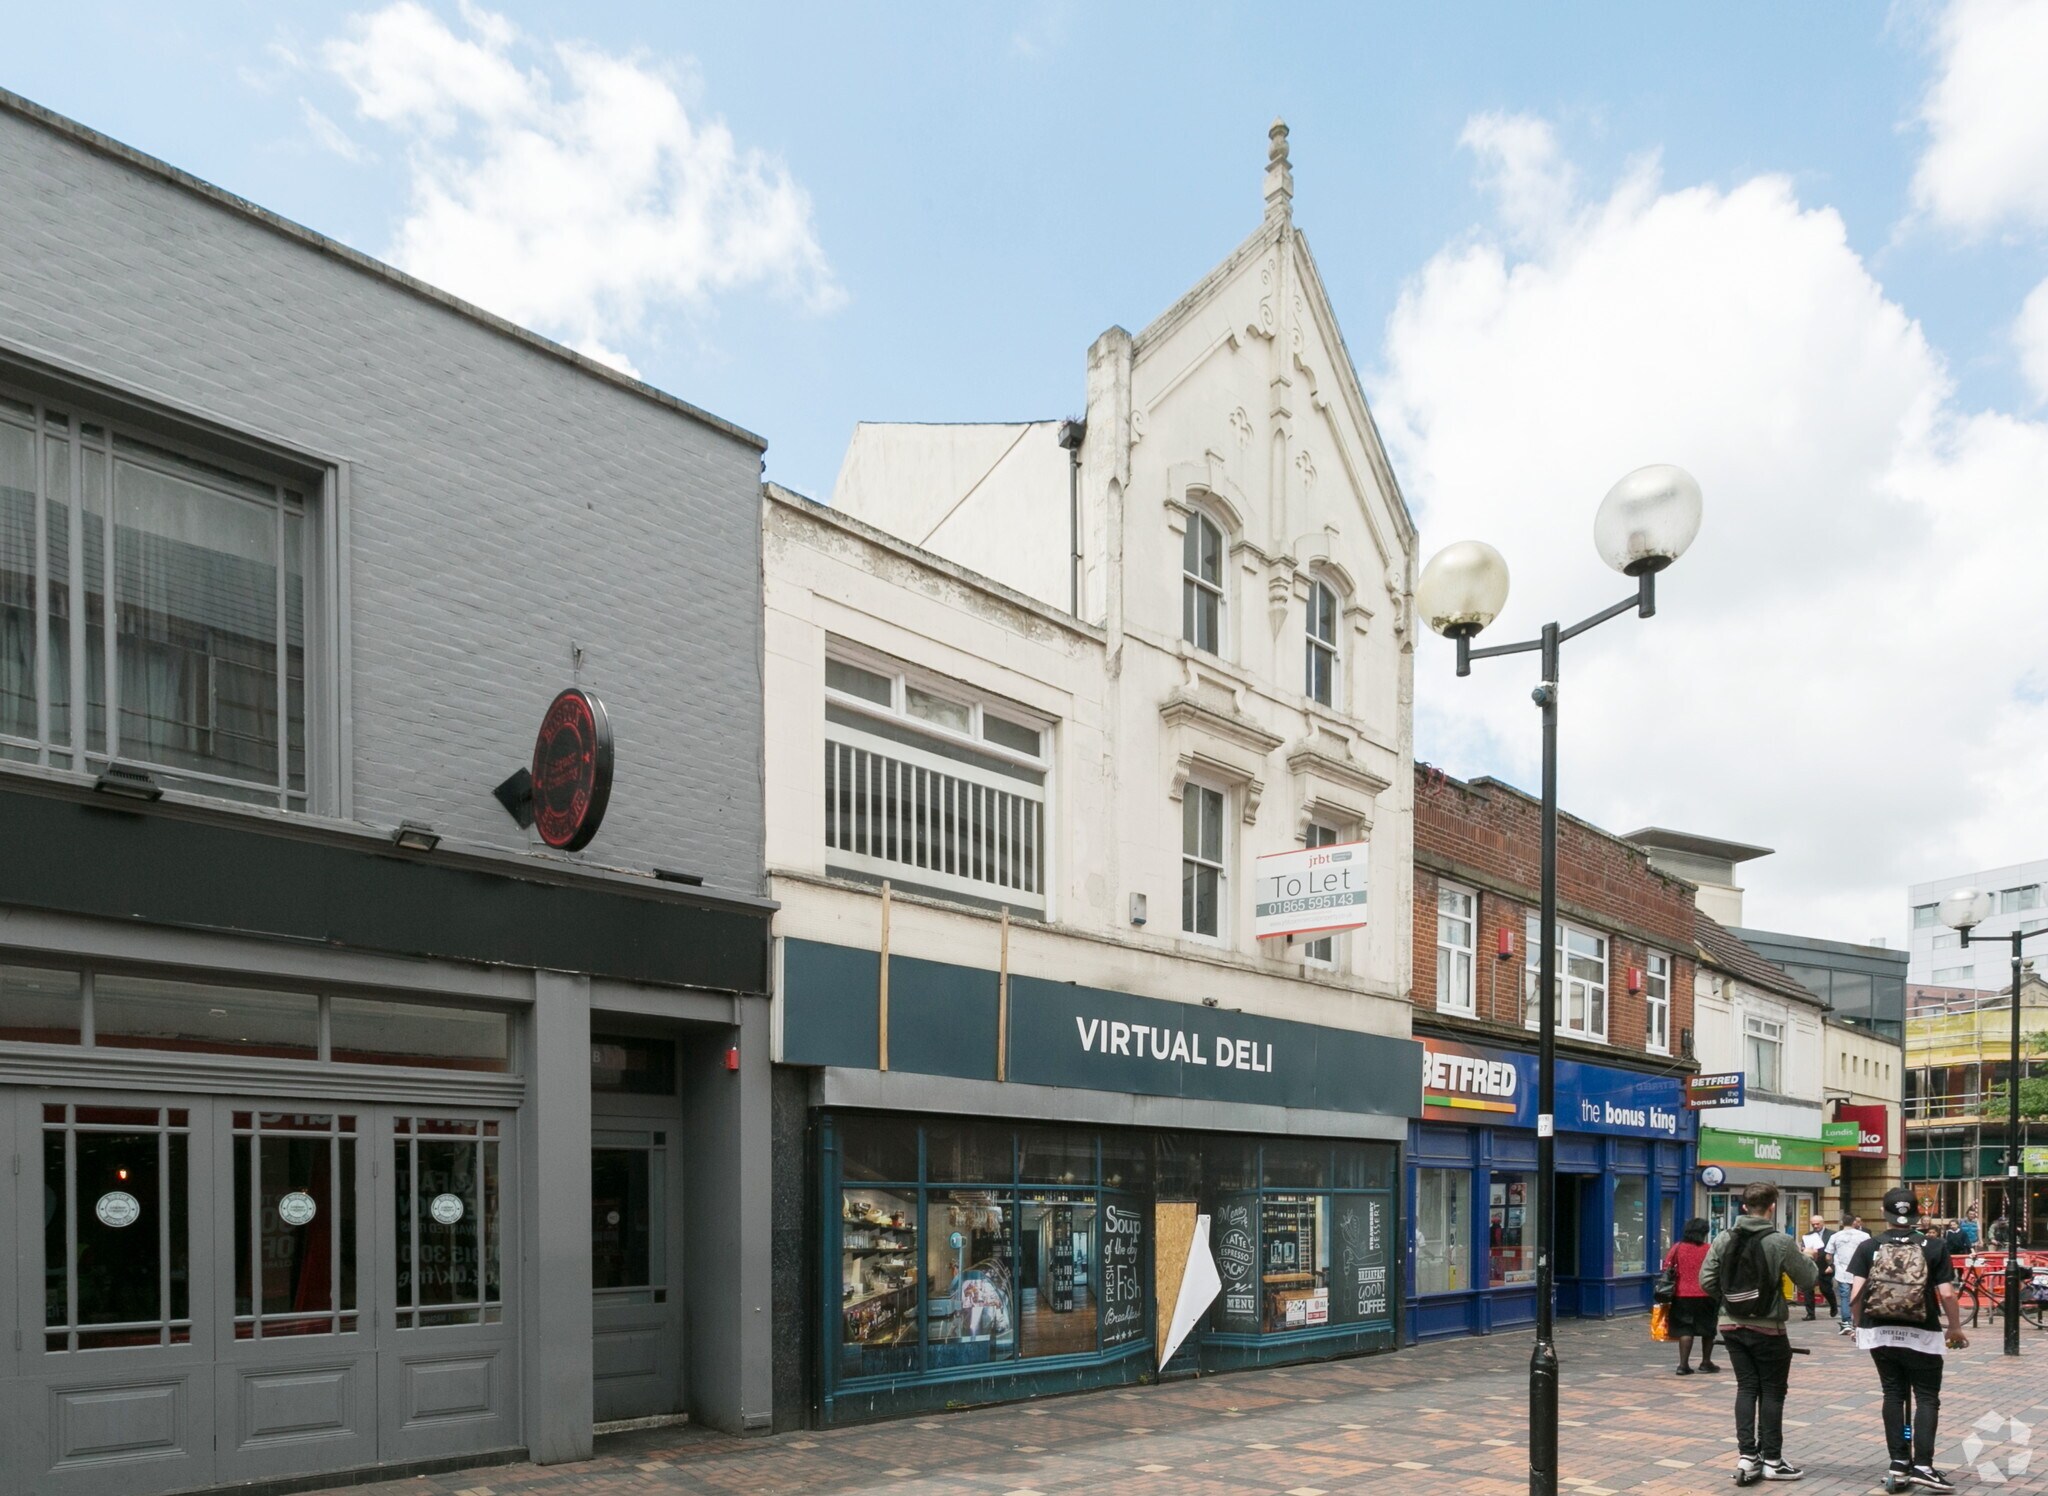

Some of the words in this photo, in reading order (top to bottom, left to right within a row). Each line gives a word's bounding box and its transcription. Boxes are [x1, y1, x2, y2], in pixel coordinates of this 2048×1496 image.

[1309, 853, 1330, 868] jrbt
[1270, 875, 1301, 898] To
[1309, 868, 1350, 894] Let
[1268, 899, 1305, 915] 01865
[1308, 893, 1354, 910] 595143
[1075, 1016, 1207, 1065] VIRTUAL
[1215, 1036, 1273, 1073] DELI
[1691, 1075, 1740, 1087] BETFRED
[1719, 1097, 1739, 1105] king
[1581, 1098, 1600, 1123] the
[1605, 1101, 1645, 1128] bonus
[1650, 1106, 1676, 1135] king
[1825, 1128, 1854, 1137] Londis
[1754, 1137, 1782, 1161] Londis
[1105, 1204, 1142, 1243] Soup
[1104, 1237, 1114, 1264] of
[1114, 1237, 1126, 1256] the
[1126, 1236, 1138, 1265] day
[1226, 1233, 1247, 1249] LATTE
[1220, 1248, 1250, 1262] ESPRESSO
[1105, 1264, 1115, 1303] FRESH
[1117, 1264, 1142, 1302] Fish
[1357, 1269, 1386, 1281] BREAKFAST
[1104, 1302, 1142, 1326] Breakfast
[1226, 1297, 1255, 1310] MENU
[1357, 1298, 1386, 1315] COFFEE
